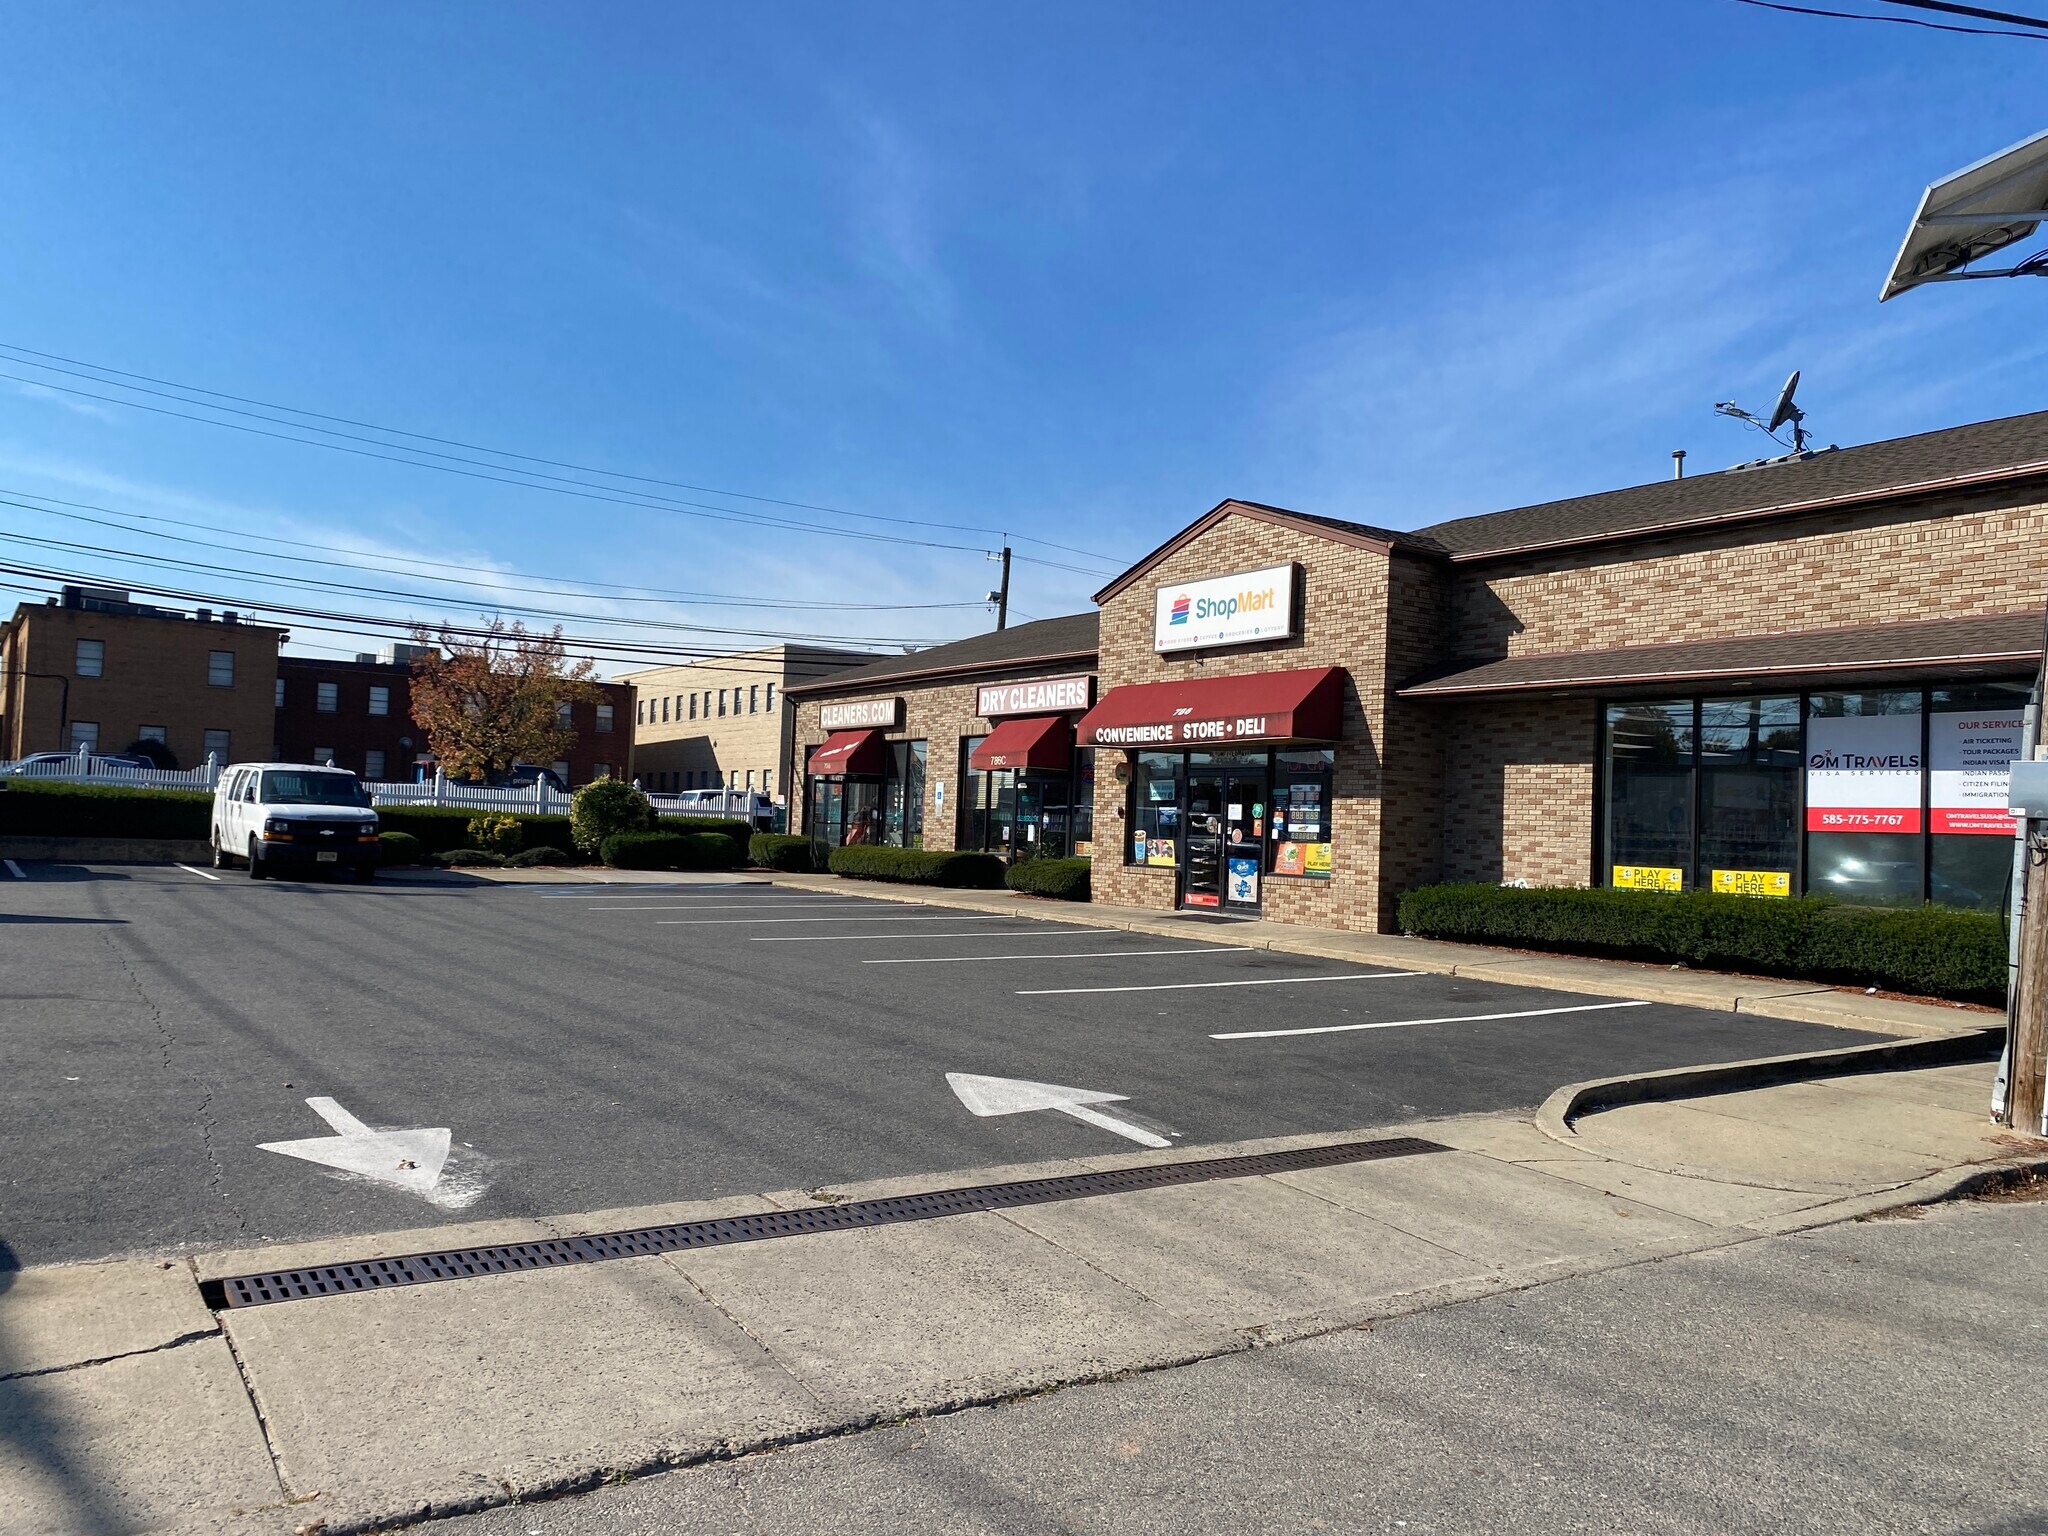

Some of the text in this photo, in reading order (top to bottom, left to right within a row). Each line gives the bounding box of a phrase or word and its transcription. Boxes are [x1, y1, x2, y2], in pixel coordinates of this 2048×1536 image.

[1196, 588, 1276, 620] ShopMart
[980, 681, 1086, 713] DRY CLEANERS
[821, 701, 894, 726] CLEANERS.COM
[1173, 707, 1193, 716] 786
[1096, 717, 1266, 743] CONVENIENCE STORE DELI
[1958, 719, 2024, 730] OUR SERVICE
[990, 755, 1007, 766] 786C
[1842, 753, 1919, 769] TRAVELS
[1822, 814, 1903, 825] 585-775-7767
[1633, 868, 1661, 879] PLAY
[1735, 873, 1766, 884] PLAY
[1633, 877, 1661, 888] HERE
[1735, 883, 1765, 894] HERE
